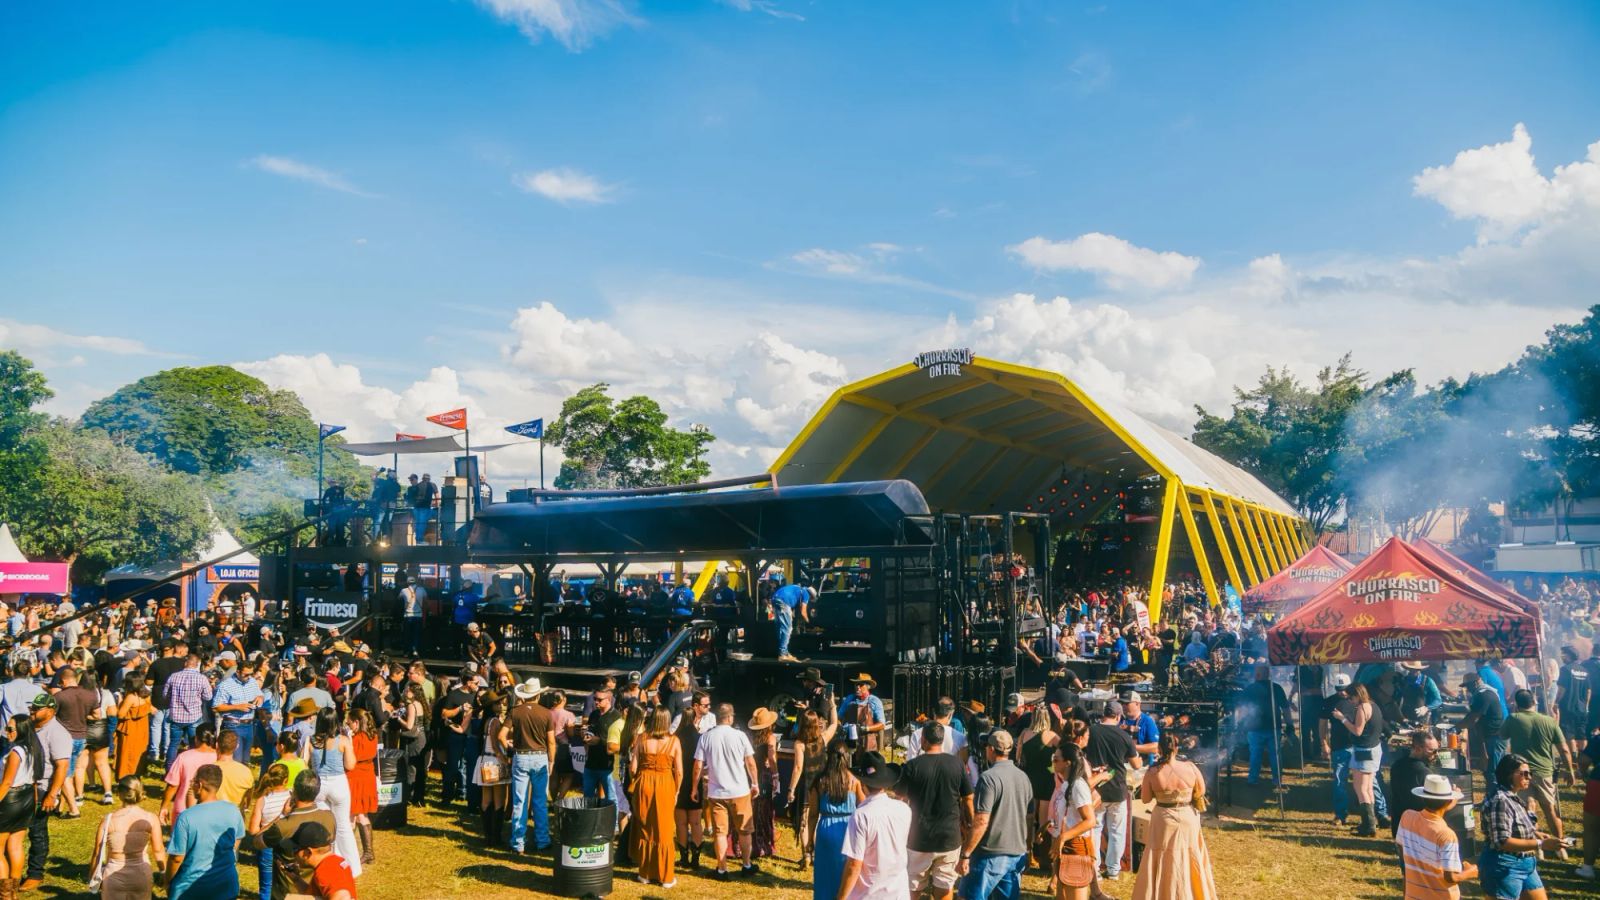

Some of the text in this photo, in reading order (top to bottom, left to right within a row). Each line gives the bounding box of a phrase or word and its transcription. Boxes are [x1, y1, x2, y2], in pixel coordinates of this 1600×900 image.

[919, 348, 970, 369] CHURRASCO
[930, 363, 961, 378] ON FIRE
[518, 423, 537, 433] Ford
[221, 569, 236, 578] LOJA
[1290, 568, 1344, 578] CHURRASCO
[1347, 578, 1439, 597] CHURRASCO
[1365, 589, 1421, 604] ON FIRE
[305, 597, 358, 618] Frimesa
[1369, 635, 1421, 651] CHURRASCO
[1380, 648, 1412, 659] ON FIRE
